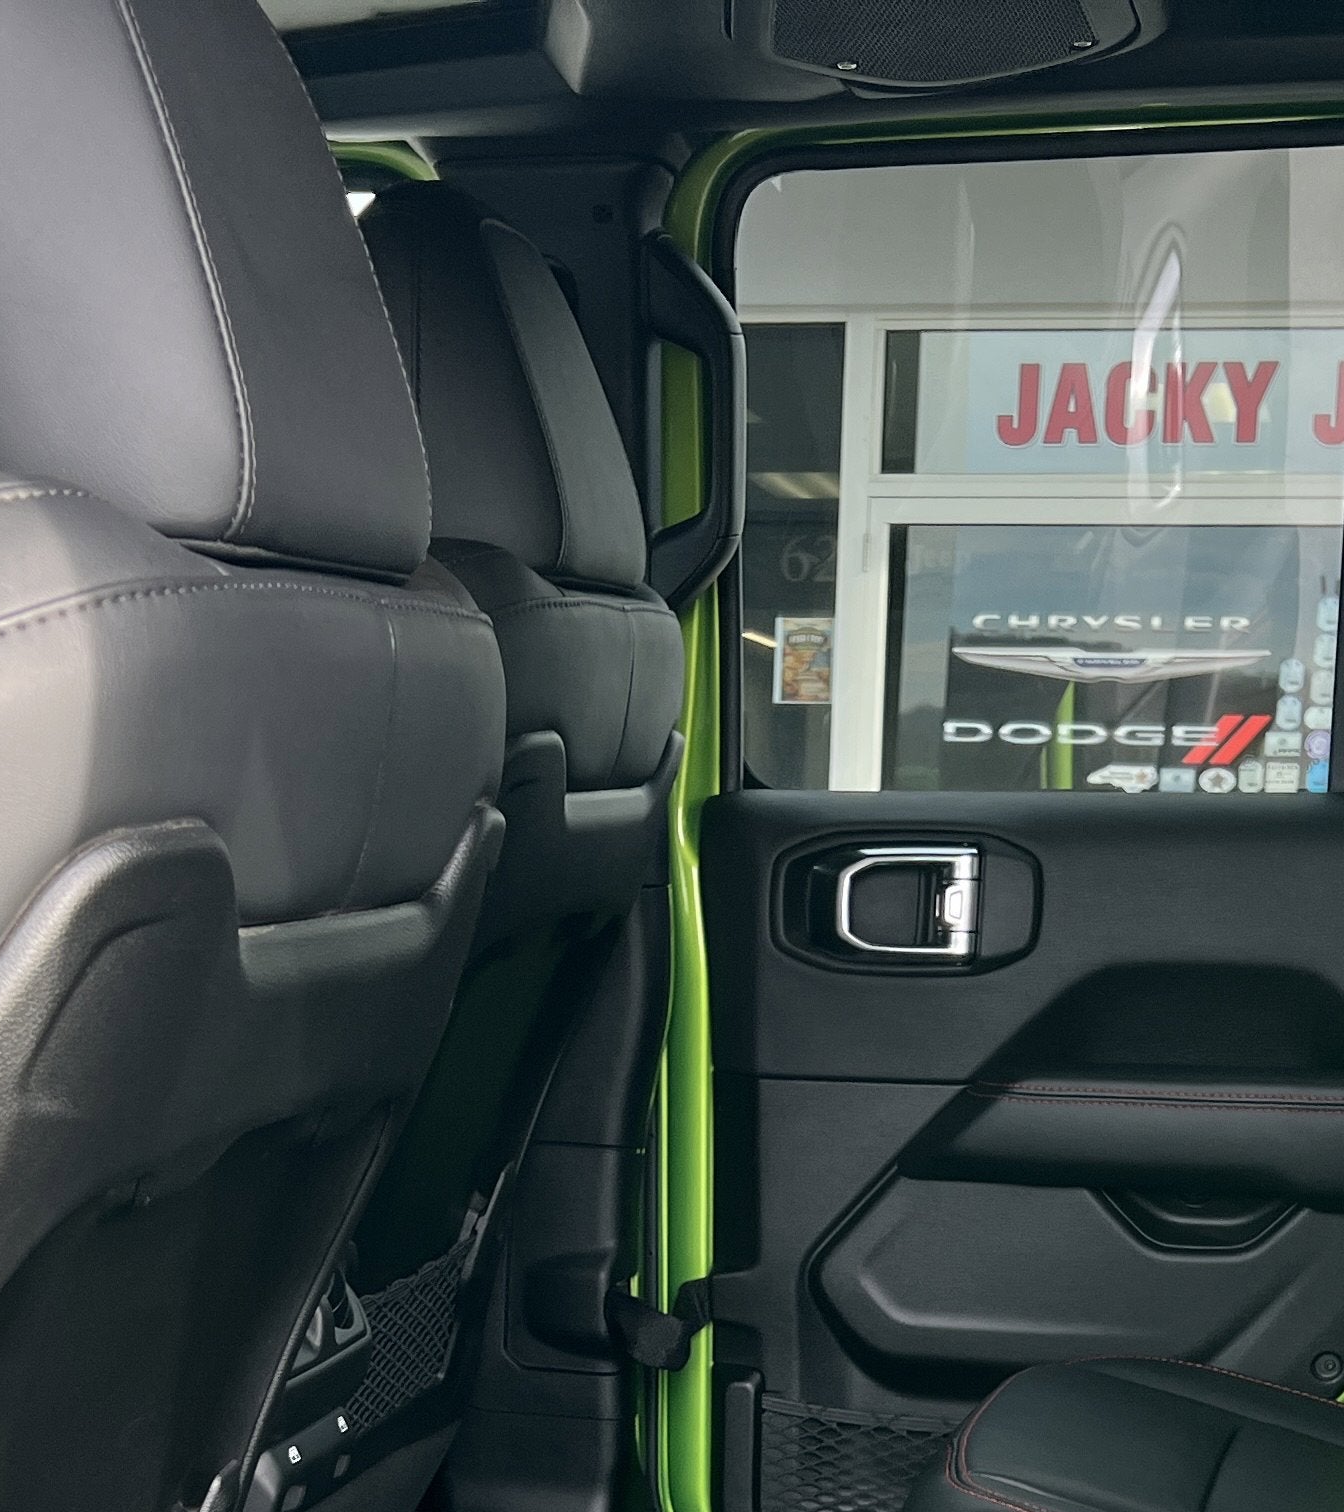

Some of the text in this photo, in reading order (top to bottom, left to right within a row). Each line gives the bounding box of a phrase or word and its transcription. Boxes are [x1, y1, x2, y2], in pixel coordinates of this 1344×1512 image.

[996, 359, 1280, 446] JACKY
[971, 614, 1251, 633] CHRYSLER
[942, 719, 1220, 747] DODGE
